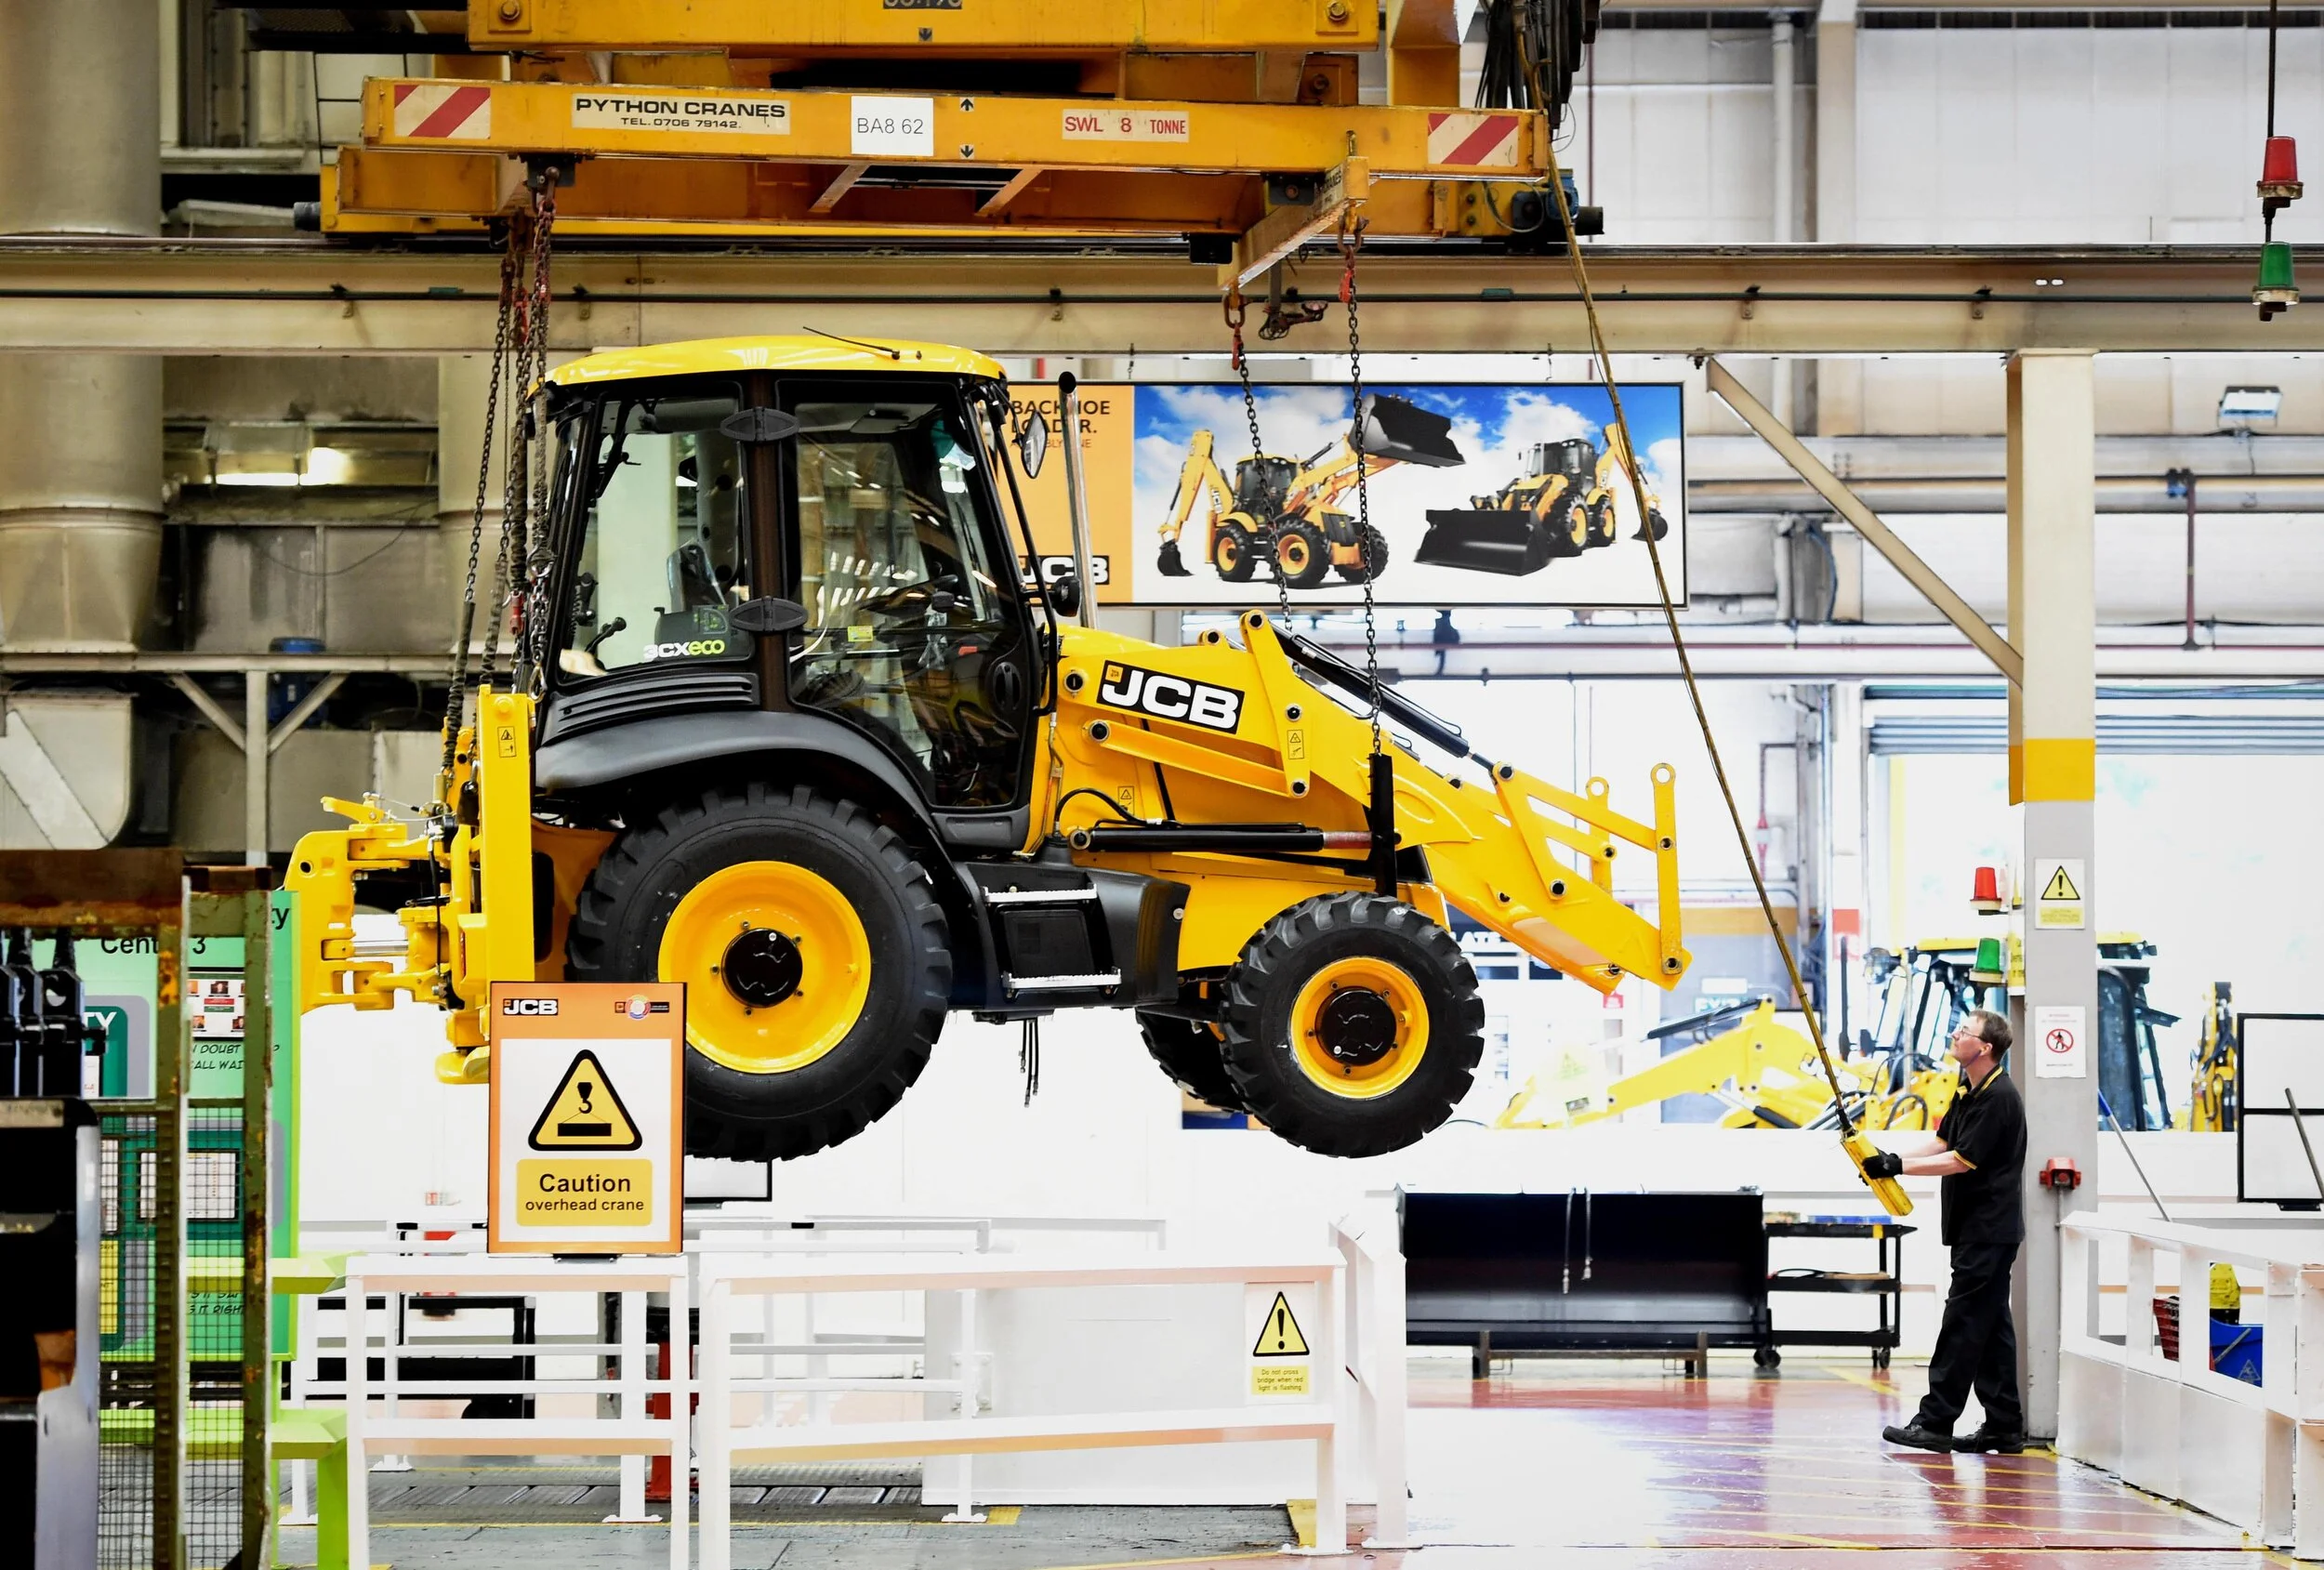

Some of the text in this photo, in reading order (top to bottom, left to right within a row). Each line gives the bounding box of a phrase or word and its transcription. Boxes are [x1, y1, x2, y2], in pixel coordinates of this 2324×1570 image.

[576, 99, 786, 118] PYTHON CRANES
[857, 117, 924, 135] BA8 62
[1064, 116, 1186, 135] SWL 8 TONNE
[1102, 669, 1239, 729] JCB
[504, 999, 558, 1015] JCB
[200, 1045, 241, 1054] DOUBT
[539, 1173, 631, 1193] Caution
[525, 1198, 644, 1211] overhead crane
